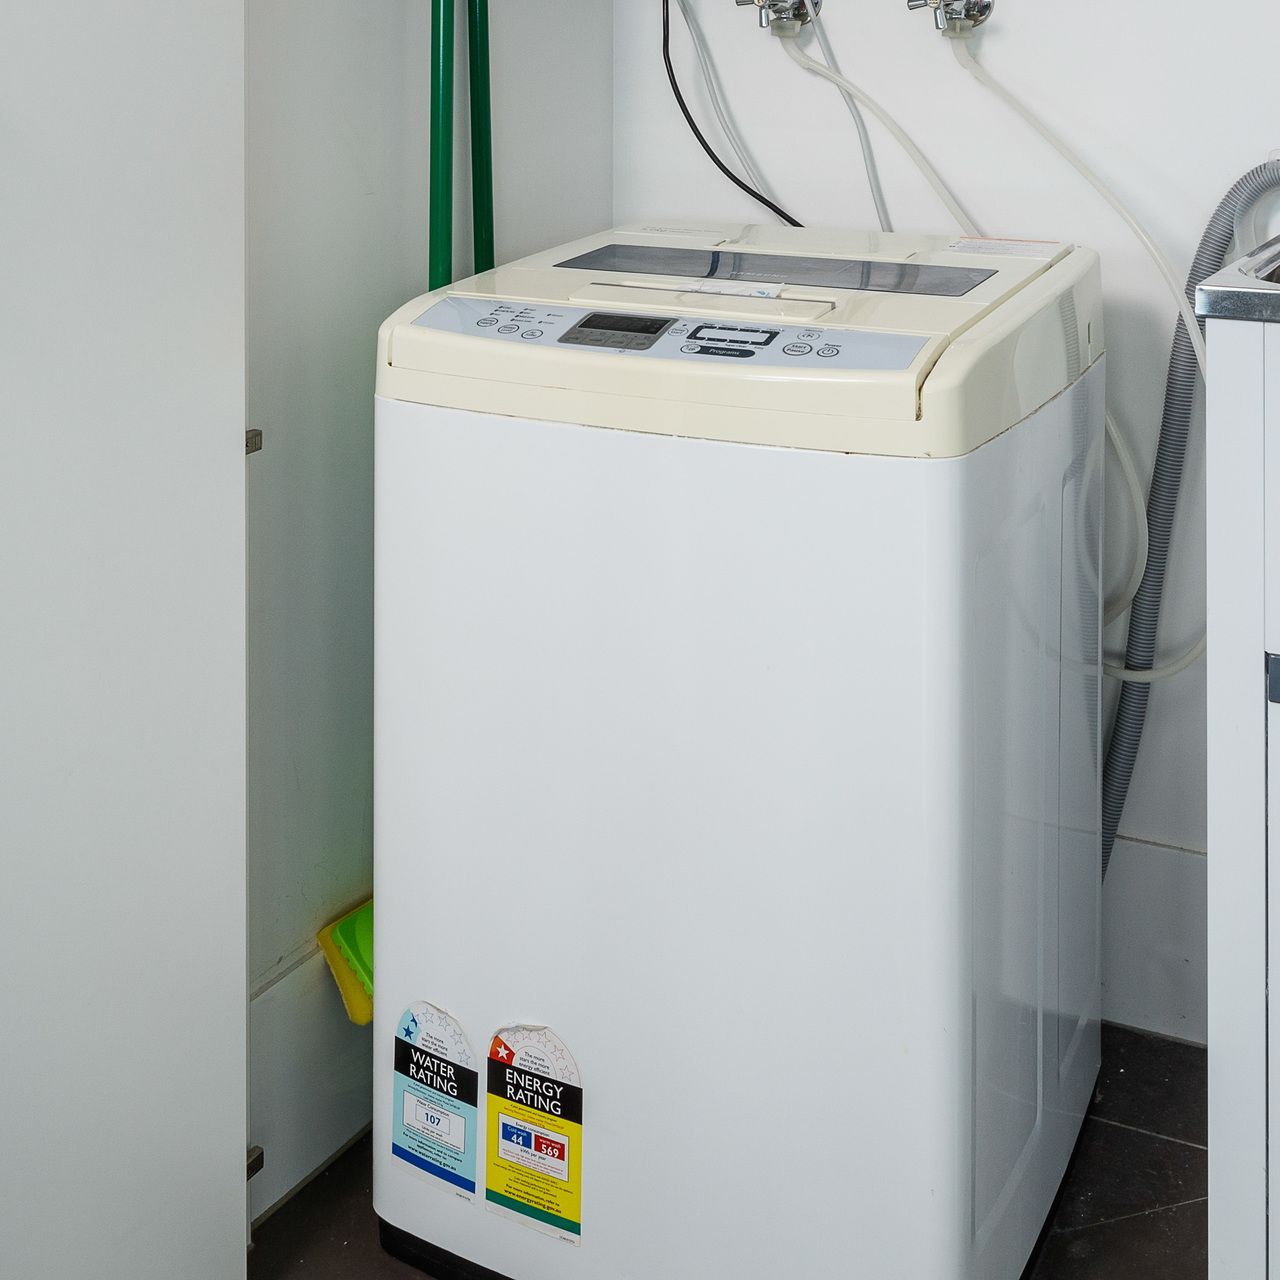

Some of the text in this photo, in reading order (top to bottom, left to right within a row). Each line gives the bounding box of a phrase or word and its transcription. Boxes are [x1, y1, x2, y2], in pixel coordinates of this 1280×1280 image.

[433, 1048, 448, 1056] efficient
[411, 1048, 456, 1080] WATER
[519, 1062, 550, 1076] energy efficient
[410, 1064, 458, 1096] RATING
[506, 1068, 564, 1099] ENERGY
[507, 1084, 562, 1115] RATING
[425, 1112, 440, 1126] 107
[427, 1104, 450, 1116] Consumption
[516, 1122, 528, 1130] Energy
[511, 1134, 523, 1146] 44
[408, 1145, 456, 1171] www.waterrating.gov.au
[418, 1138, 436, 1150] information
[448, 1154, 462, 1162] compare
[541, 1144, 559, 1158] 569
[504, 1189, 562, 1214] www.energyrating.gov.au
